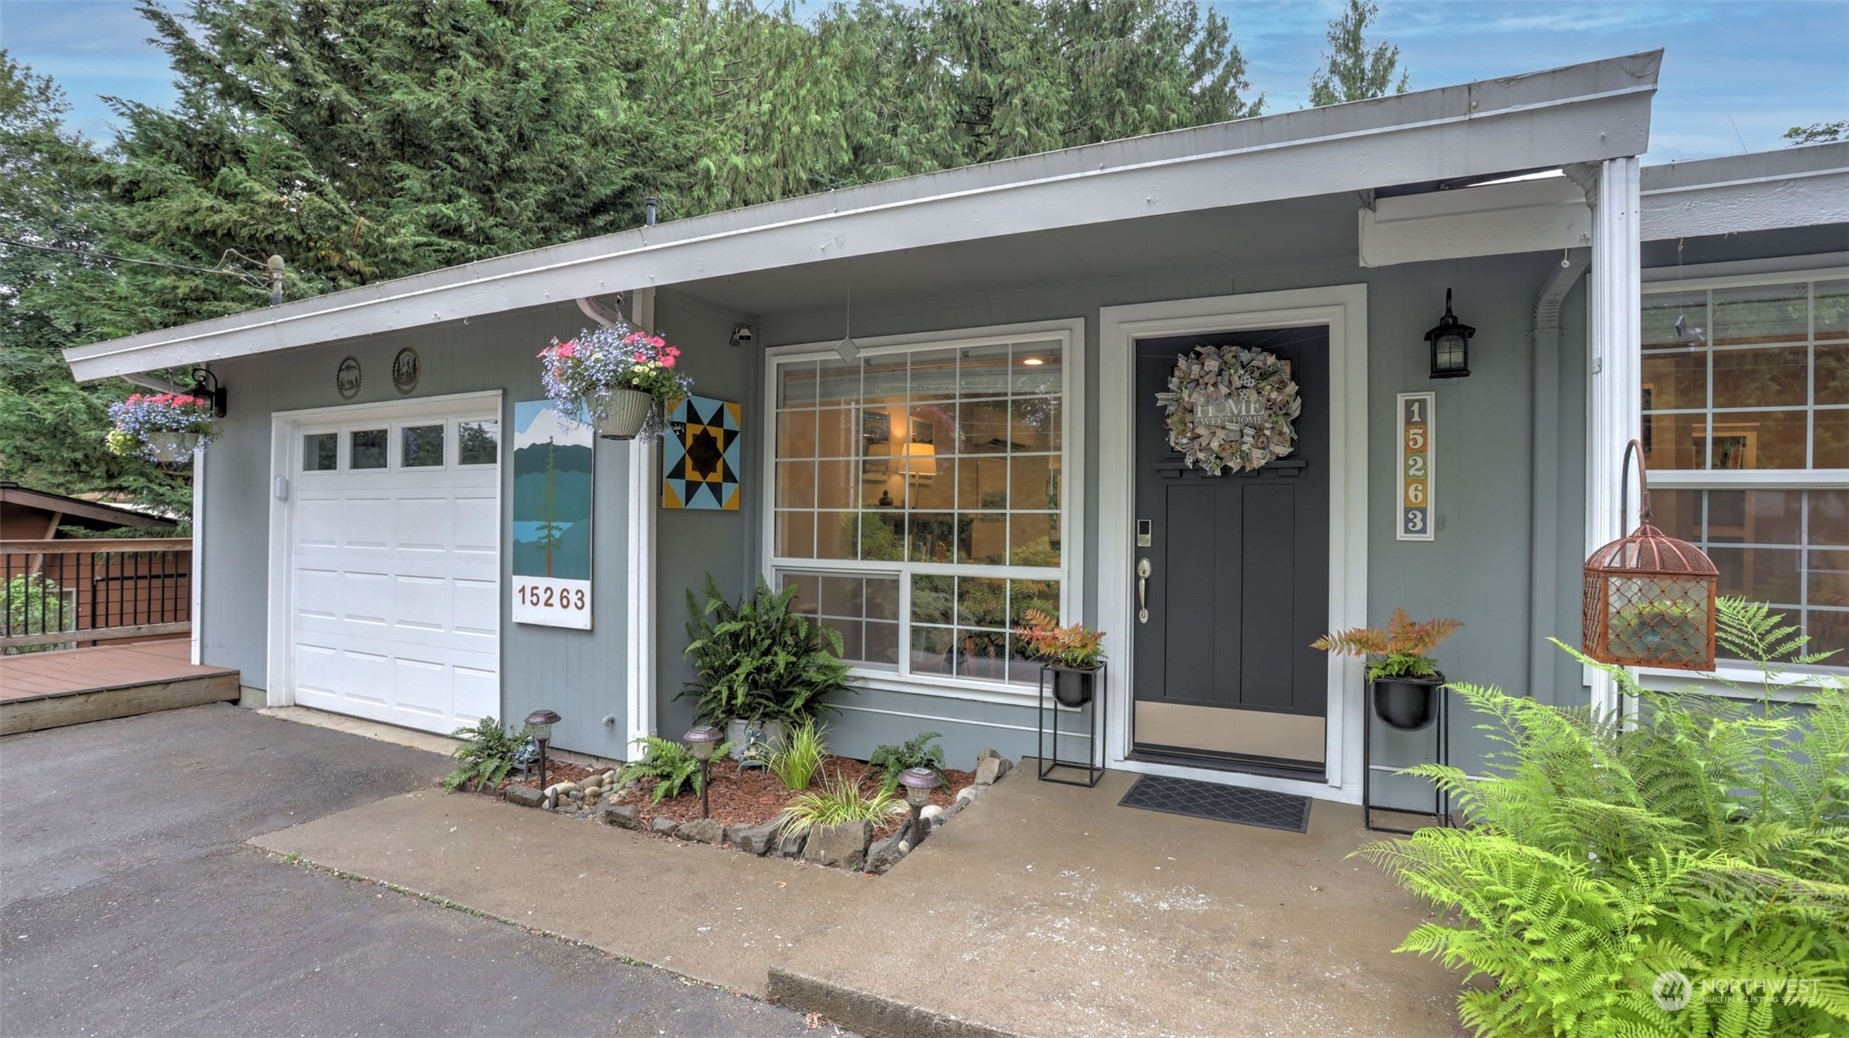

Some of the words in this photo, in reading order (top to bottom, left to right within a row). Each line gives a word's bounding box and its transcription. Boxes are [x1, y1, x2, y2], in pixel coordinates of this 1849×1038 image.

[1233, 416, 1263, 425] HOME
[1408, 401, 1424, 531] 15263
[518, 585, 585, 611] 15263
